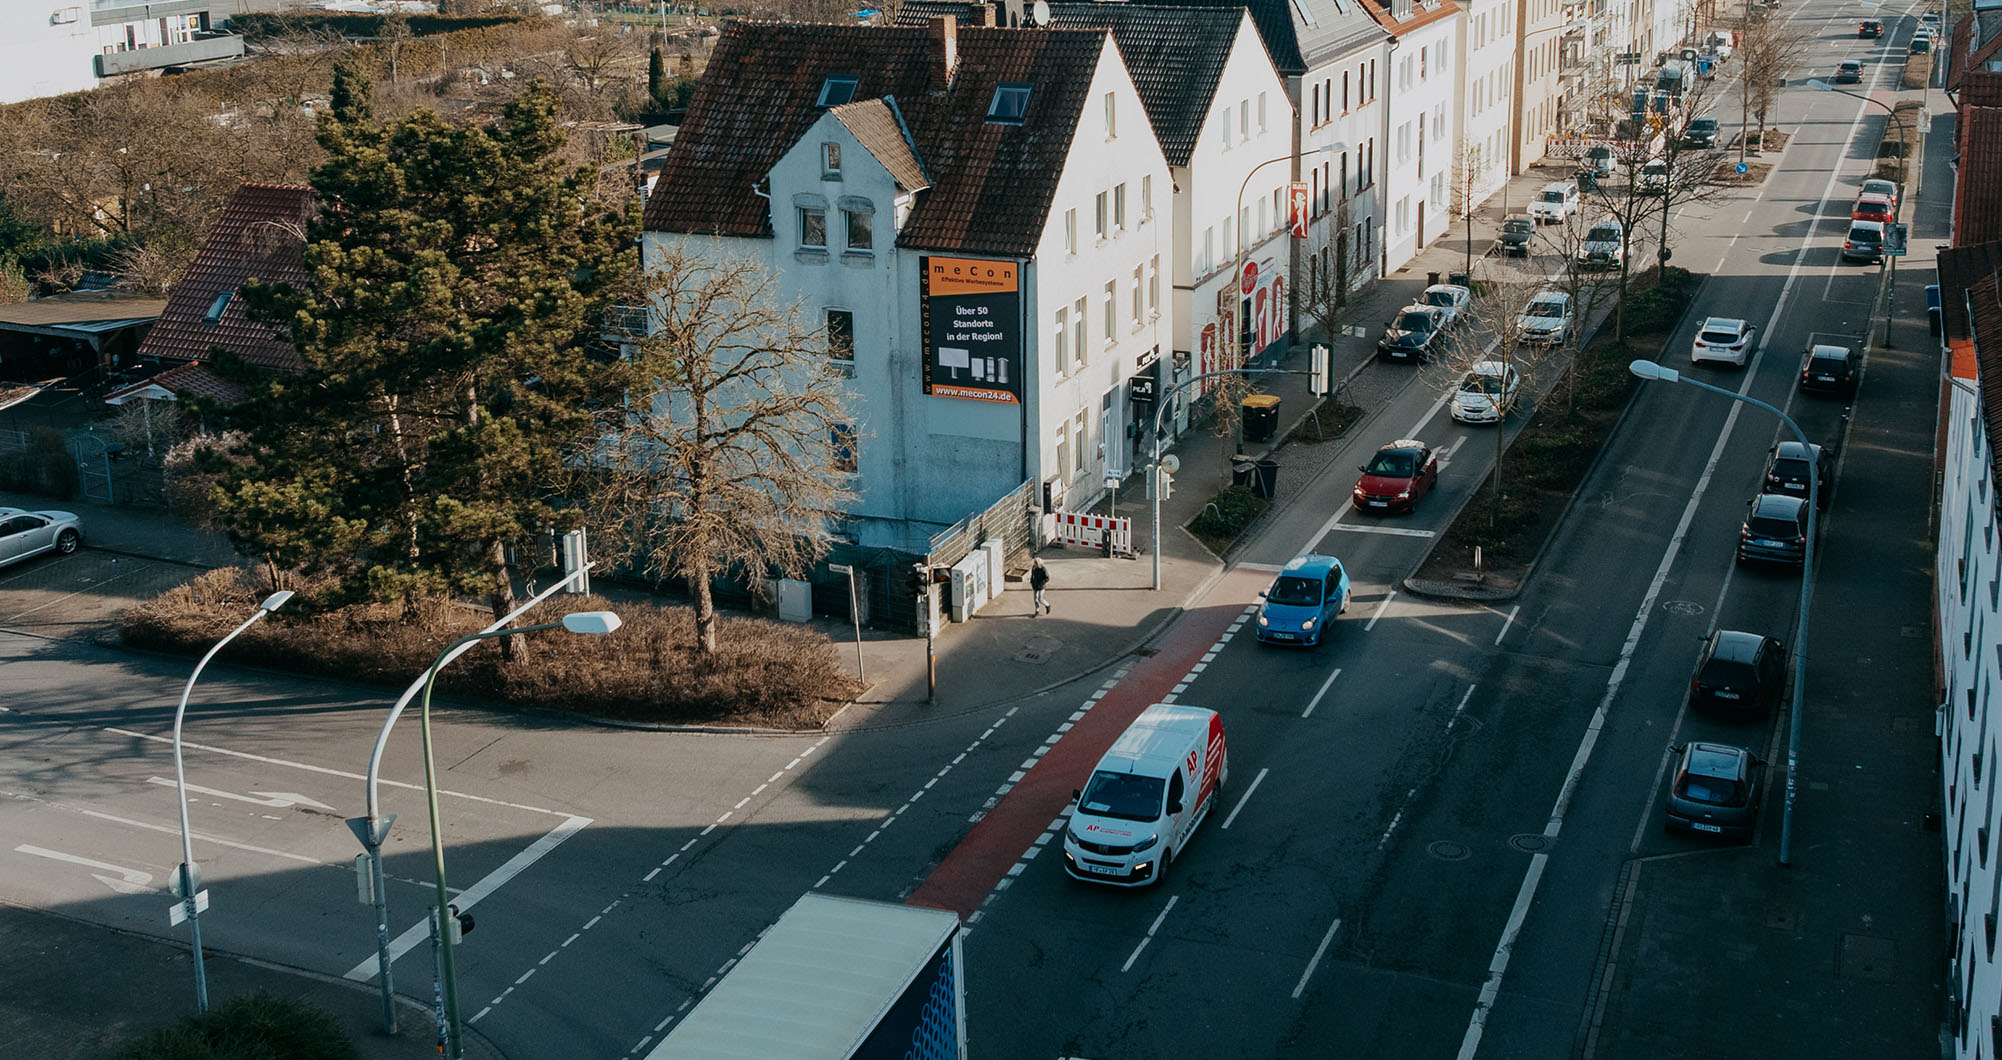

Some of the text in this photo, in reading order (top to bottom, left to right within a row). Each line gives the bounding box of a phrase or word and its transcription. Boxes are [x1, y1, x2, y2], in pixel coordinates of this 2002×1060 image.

[955, 305, 988, 315] Über 50
[953, 319, 994, 328] Standorte
[921, 269, 931, 393] www.mecon24.de
[946, 332, 1003, 342] in der Region!
[935, 387, 1011, 400] www.mecon24.de
[1186, 750, 1198, 776] AP
[1086, 824, 1100, 832] AP
